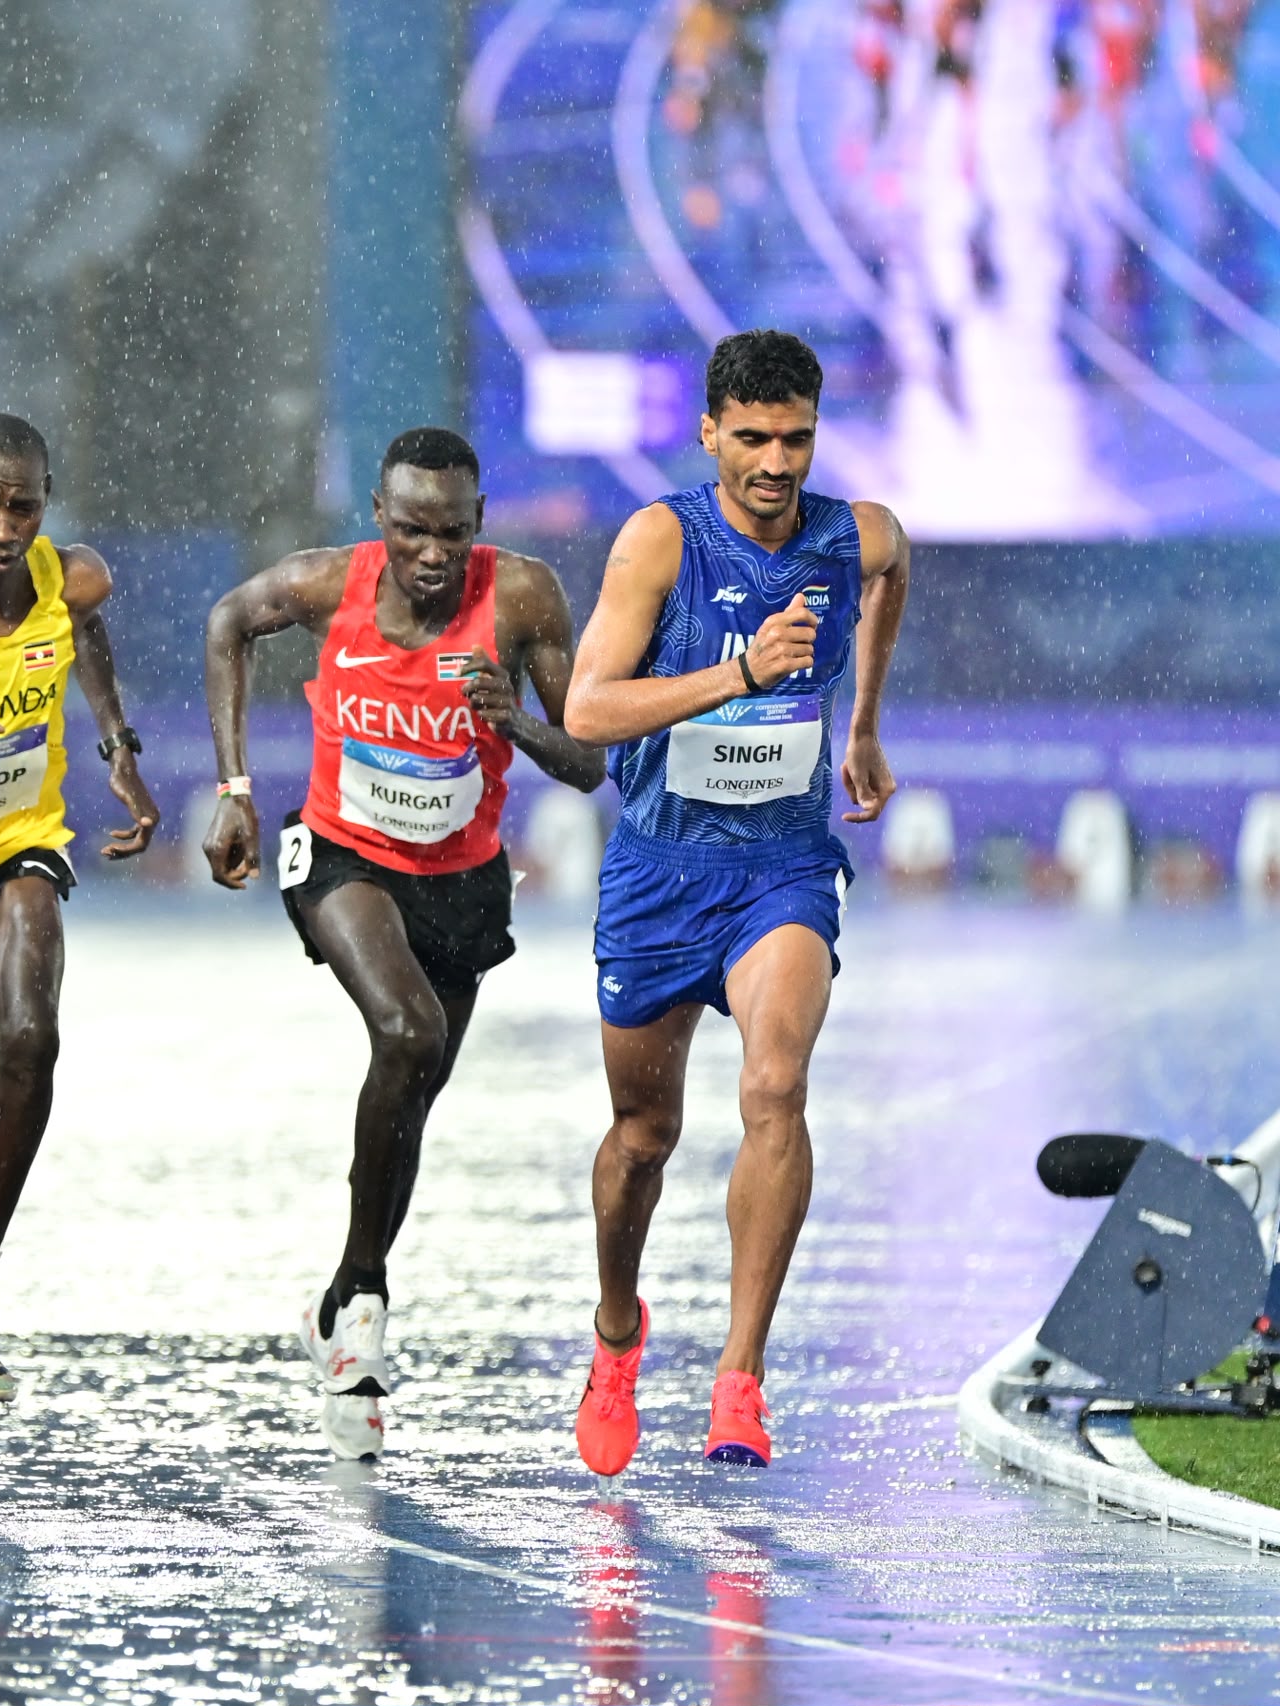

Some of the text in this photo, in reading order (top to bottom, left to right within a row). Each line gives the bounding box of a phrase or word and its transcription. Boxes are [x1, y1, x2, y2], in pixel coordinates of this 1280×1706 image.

[710, 585, 748, 604] JSW
[805, 594, 830, 606] NDIA
[336, 689, 476, 741] KENYA
[755, 702, 798, 711] commonwealth
[713, 744, 782, 763] SINGH
[705, 777, 783, 790] LONGINES
[370, 783, 454, 810] KURGAT
[373, 812, 449, 832] LONGINES
[288, 837, 302, 873] 2
